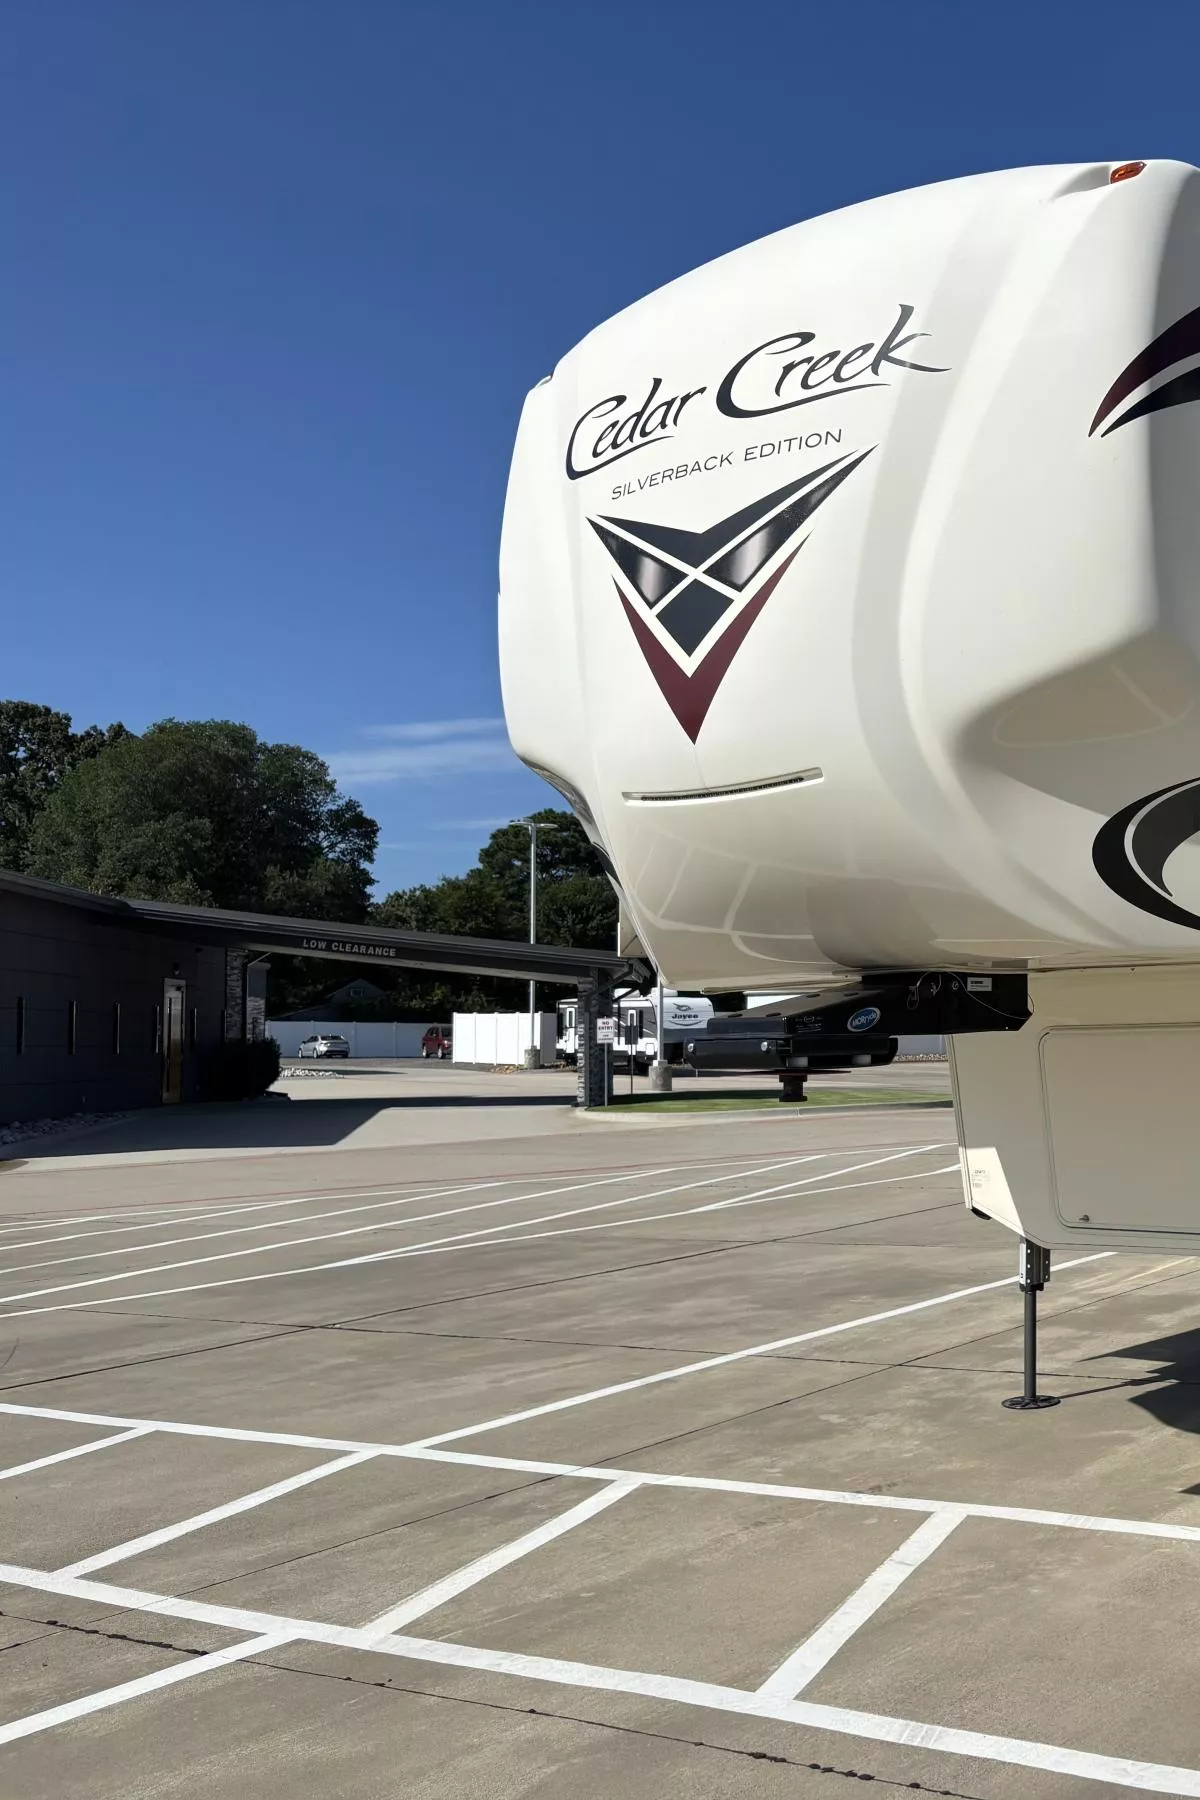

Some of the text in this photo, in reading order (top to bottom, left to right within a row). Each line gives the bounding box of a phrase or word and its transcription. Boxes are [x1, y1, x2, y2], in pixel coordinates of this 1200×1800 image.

[565, 303, 952, 481] Cedar Creek
[611, 428, 843, 501] SILVERBACK EDITION
[303, 938, 397, 957] LOW CLEARANCE
